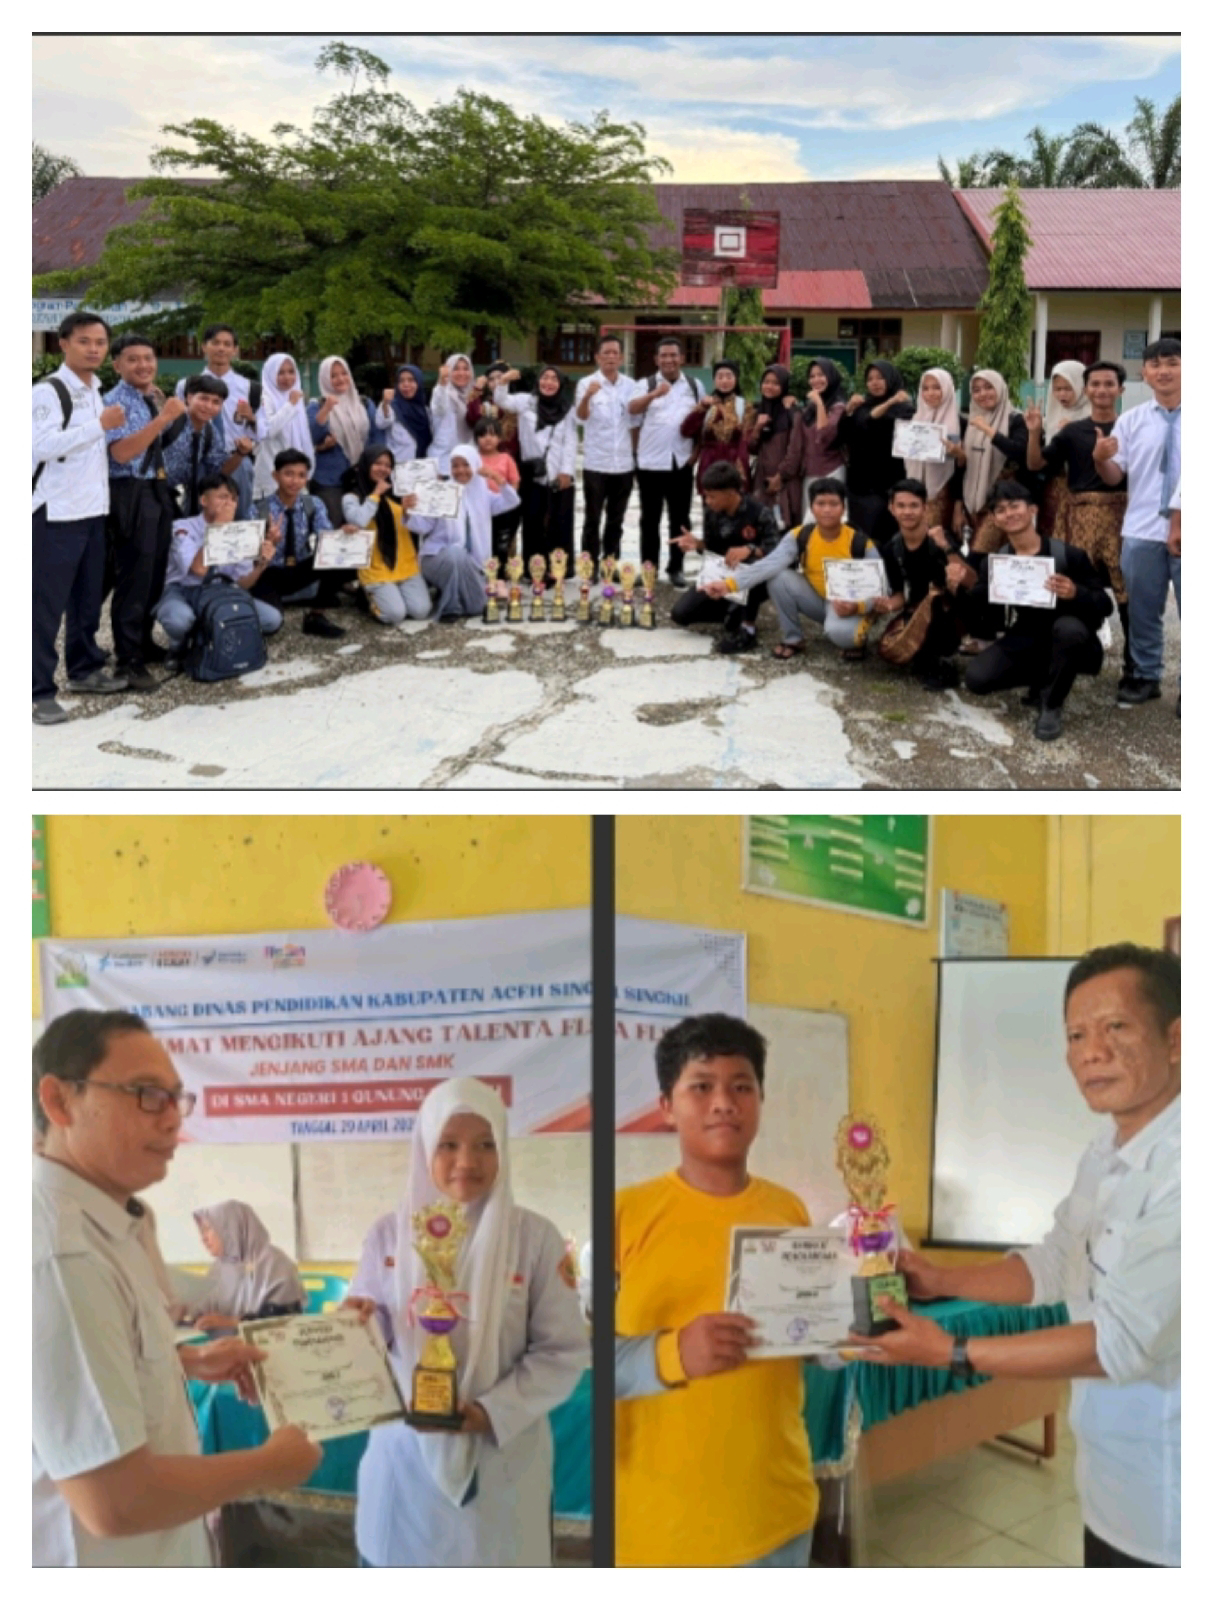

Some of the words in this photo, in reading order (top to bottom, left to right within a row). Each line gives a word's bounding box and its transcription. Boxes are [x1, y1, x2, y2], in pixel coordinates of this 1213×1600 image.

[193, 1000, 246, 1016] DINAS
[252, 994, 363, 1014] PENDIDIKAN
[367, 987, 484, 1009] KABUPATEN
[220, 1028, 346, 1052] MENGIKUTI
[353, 1026, 433, 1047] AJANG
[441, 1016, 553, 1043] TALENTA
[250, 1060, 325, 1077] JENJANG
[331, 1057, 368, 1074] SMA
[374, 1055, 411, 1072] DAN
[416, 1053, 456, 1069] SMK
[393, 1116, 415, 1132] 202
